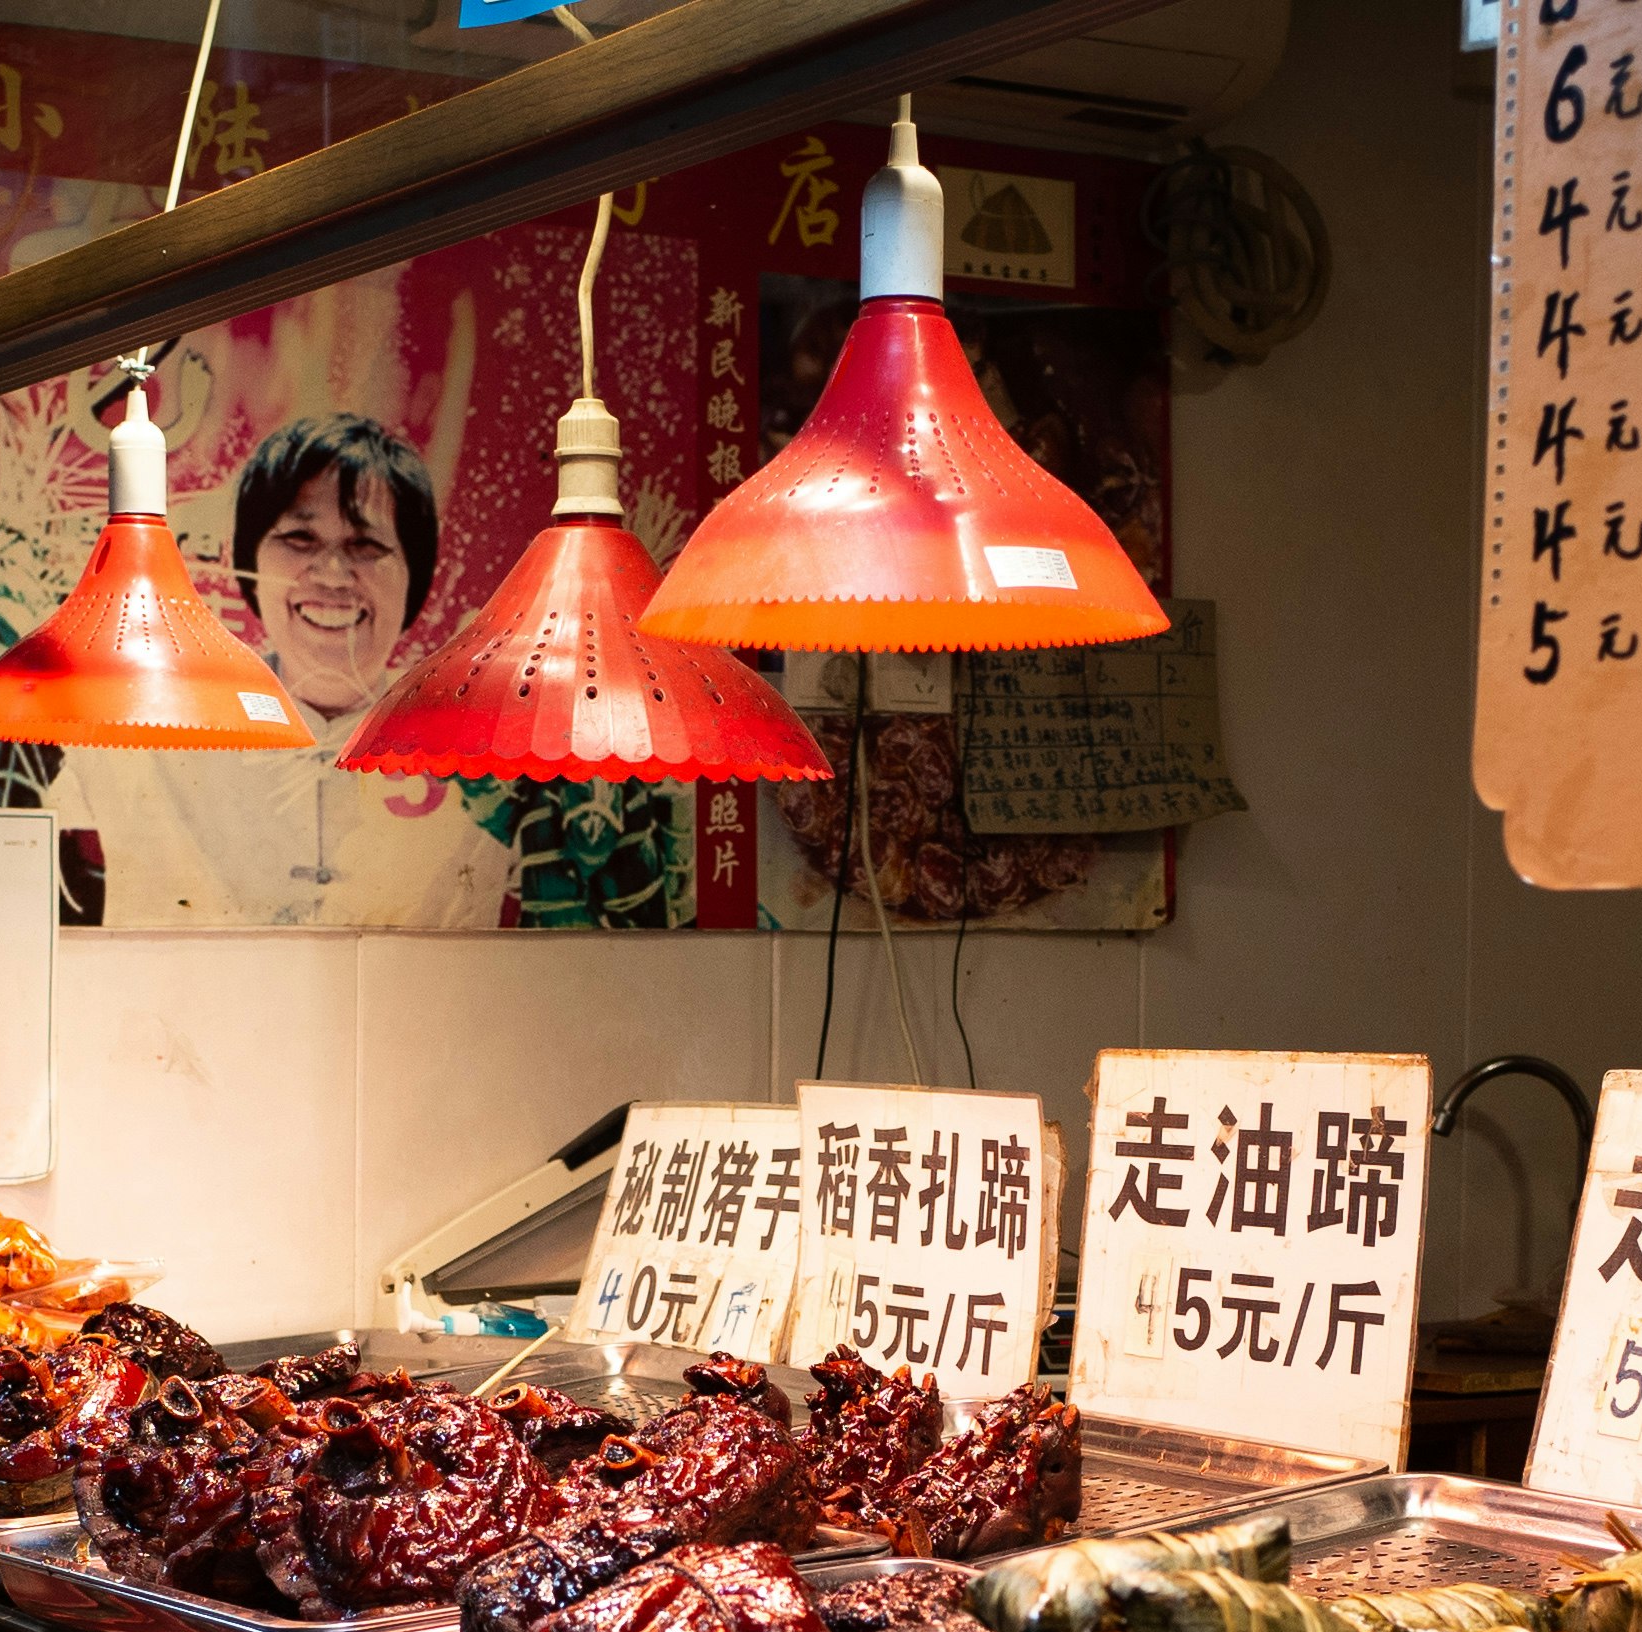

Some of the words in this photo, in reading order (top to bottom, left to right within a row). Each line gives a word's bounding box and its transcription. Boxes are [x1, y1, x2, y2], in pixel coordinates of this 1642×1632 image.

[703, 285, 745, 484] 新民晚报
[1532, 398, 1641, 485] 4元
[1523, 600, 1639, 686] 5元
[613, 1138, 801, 1251] 秘制猪手
[816, 1121, 1031, 1260] 稻香扎蹄
[1108, 1096, 1408, 1248] 走油蹄
[597, 1264, 757, 1345] 40元/斤
[1135, 1267, 1386, 1375] 45元/斤
